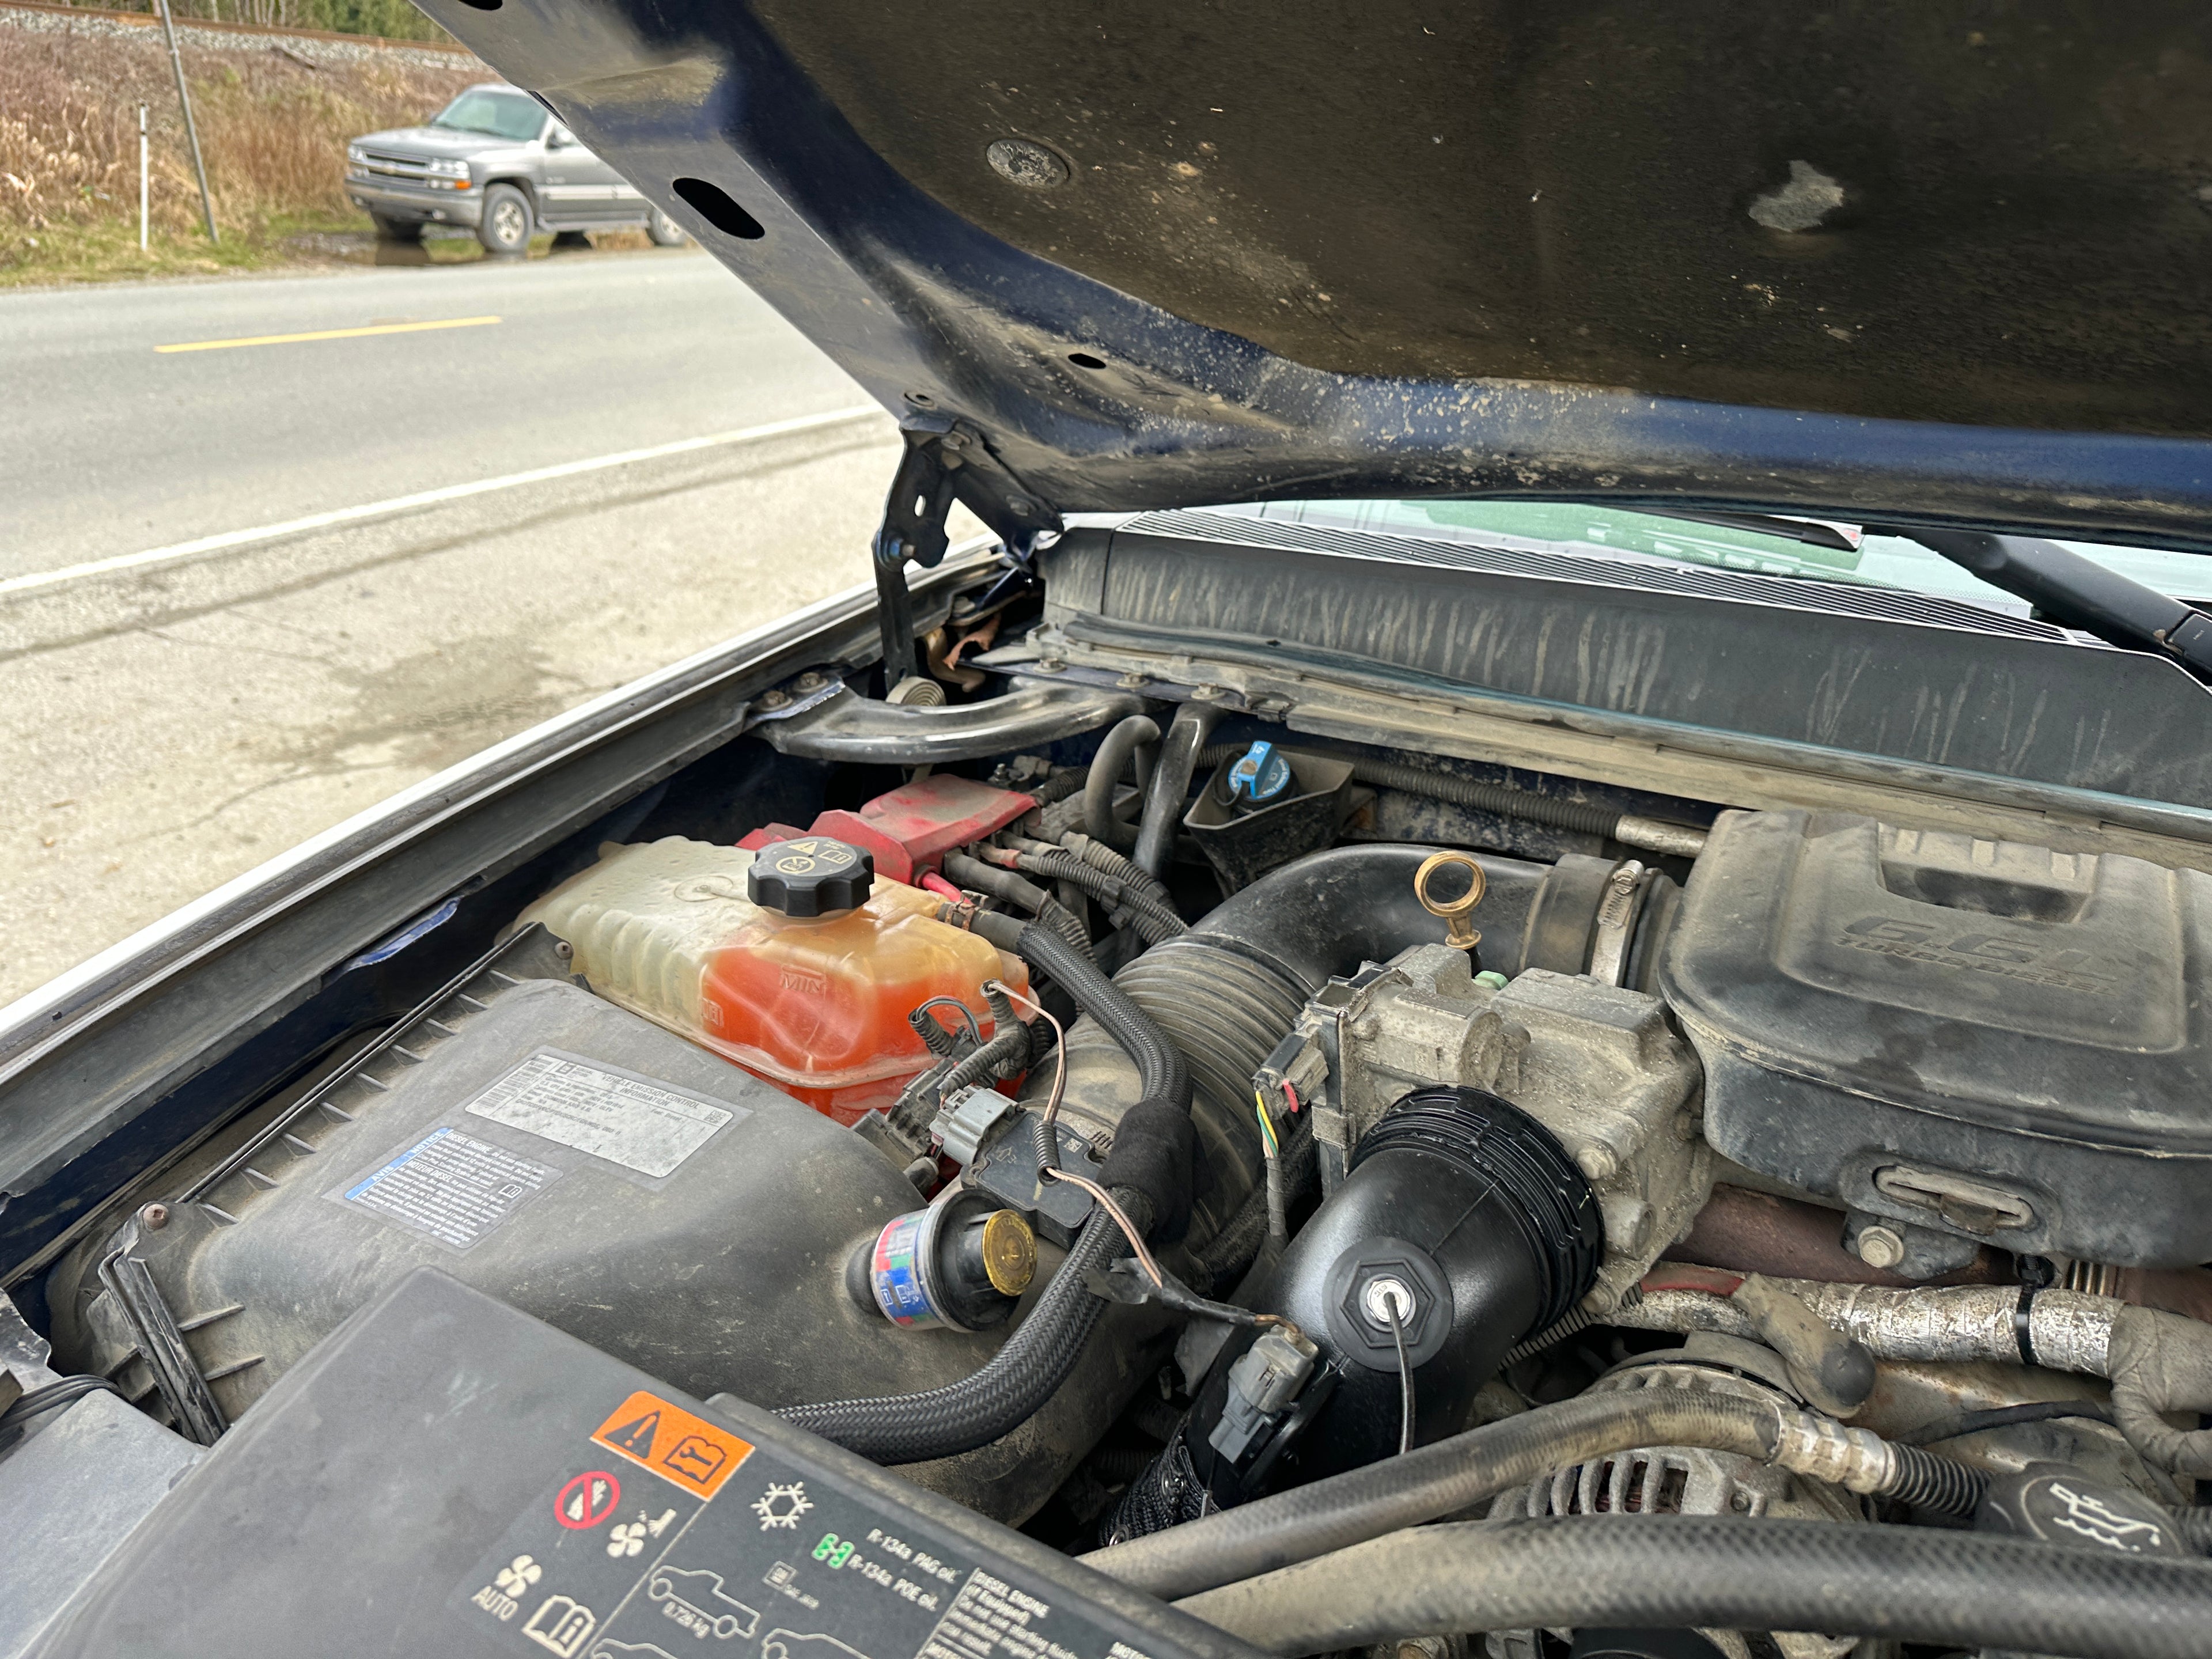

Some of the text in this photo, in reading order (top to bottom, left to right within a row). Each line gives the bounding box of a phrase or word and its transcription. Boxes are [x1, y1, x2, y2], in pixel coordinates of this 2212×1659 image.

[1844, 915, 2118, 983] 6.6L
[779, 974, 825, 995] MIN
[602, 1075, 699, 1109] VEHICLE EMISSION CONTROL
[620, 1088, 669, 1105] INFORMATION
[410, 1131, 443, 1154] NOTICE
[446, 1132, 468, 1144] DIESEL
[466, 1140, 491, 1153] ENGINE
[372, 1165, 393, 1181] AVIS
[406, 1160, 433, 1173] MOTEUR
[430, 1170, 452, 1182] DIESEL
[866, 1528, 912, 1560] R-134a
[912, 1552, 941, 1574] PAG
[847, 1554, 893, 1587] R-134a
[893, 1578, 922, 1601] POE
[470, 1585, 519, 1622] AUTO
[972, 1571, 1051, 1619] DIESEL ENGINE
